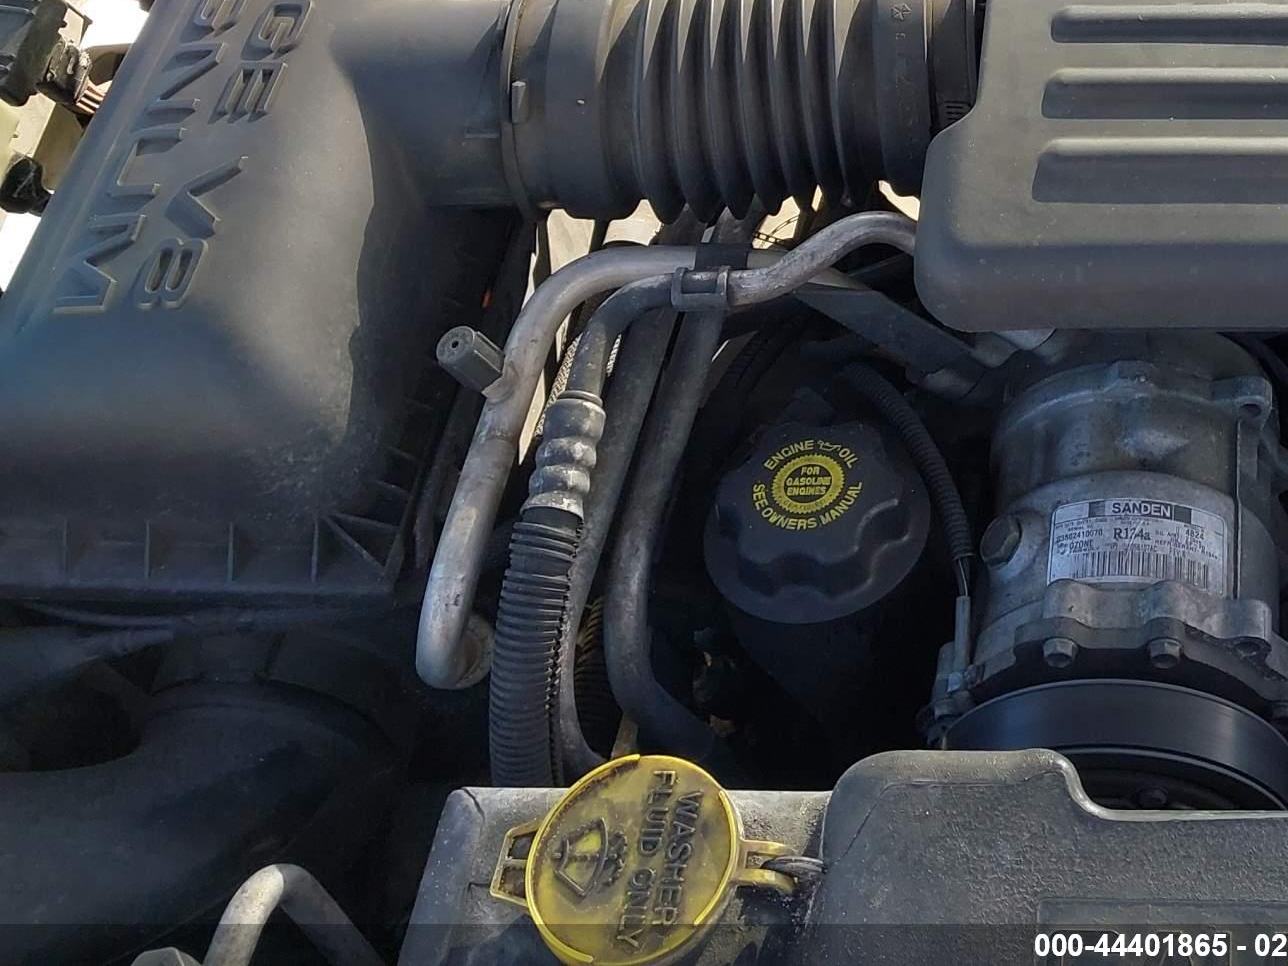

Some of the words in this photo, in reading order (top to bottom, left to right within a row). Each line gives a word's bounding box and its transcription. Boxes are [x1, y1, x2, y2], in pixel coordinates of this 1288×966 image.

[136, 155, 248, 312] V8
[764, 440, 815, 471] ENGINE
[838, 447, 859, 469] OIL
[801, 466, 820, 475] FOR
[786, 476, 832, 486] GASOLINE
[787, 486, 826, 496] ENGINES
[753, 483, 767, 510] SEE
[761, 508, 817, 530] OWNERS
[820, 481, 862, 526] MANUAL
[1111, 502, 1172, 518] SANDEN
[639, 769, 679, 857] FLUID
[651, 790, 703, 926] WASHER
[616, 868, 654, 949] ONLY
